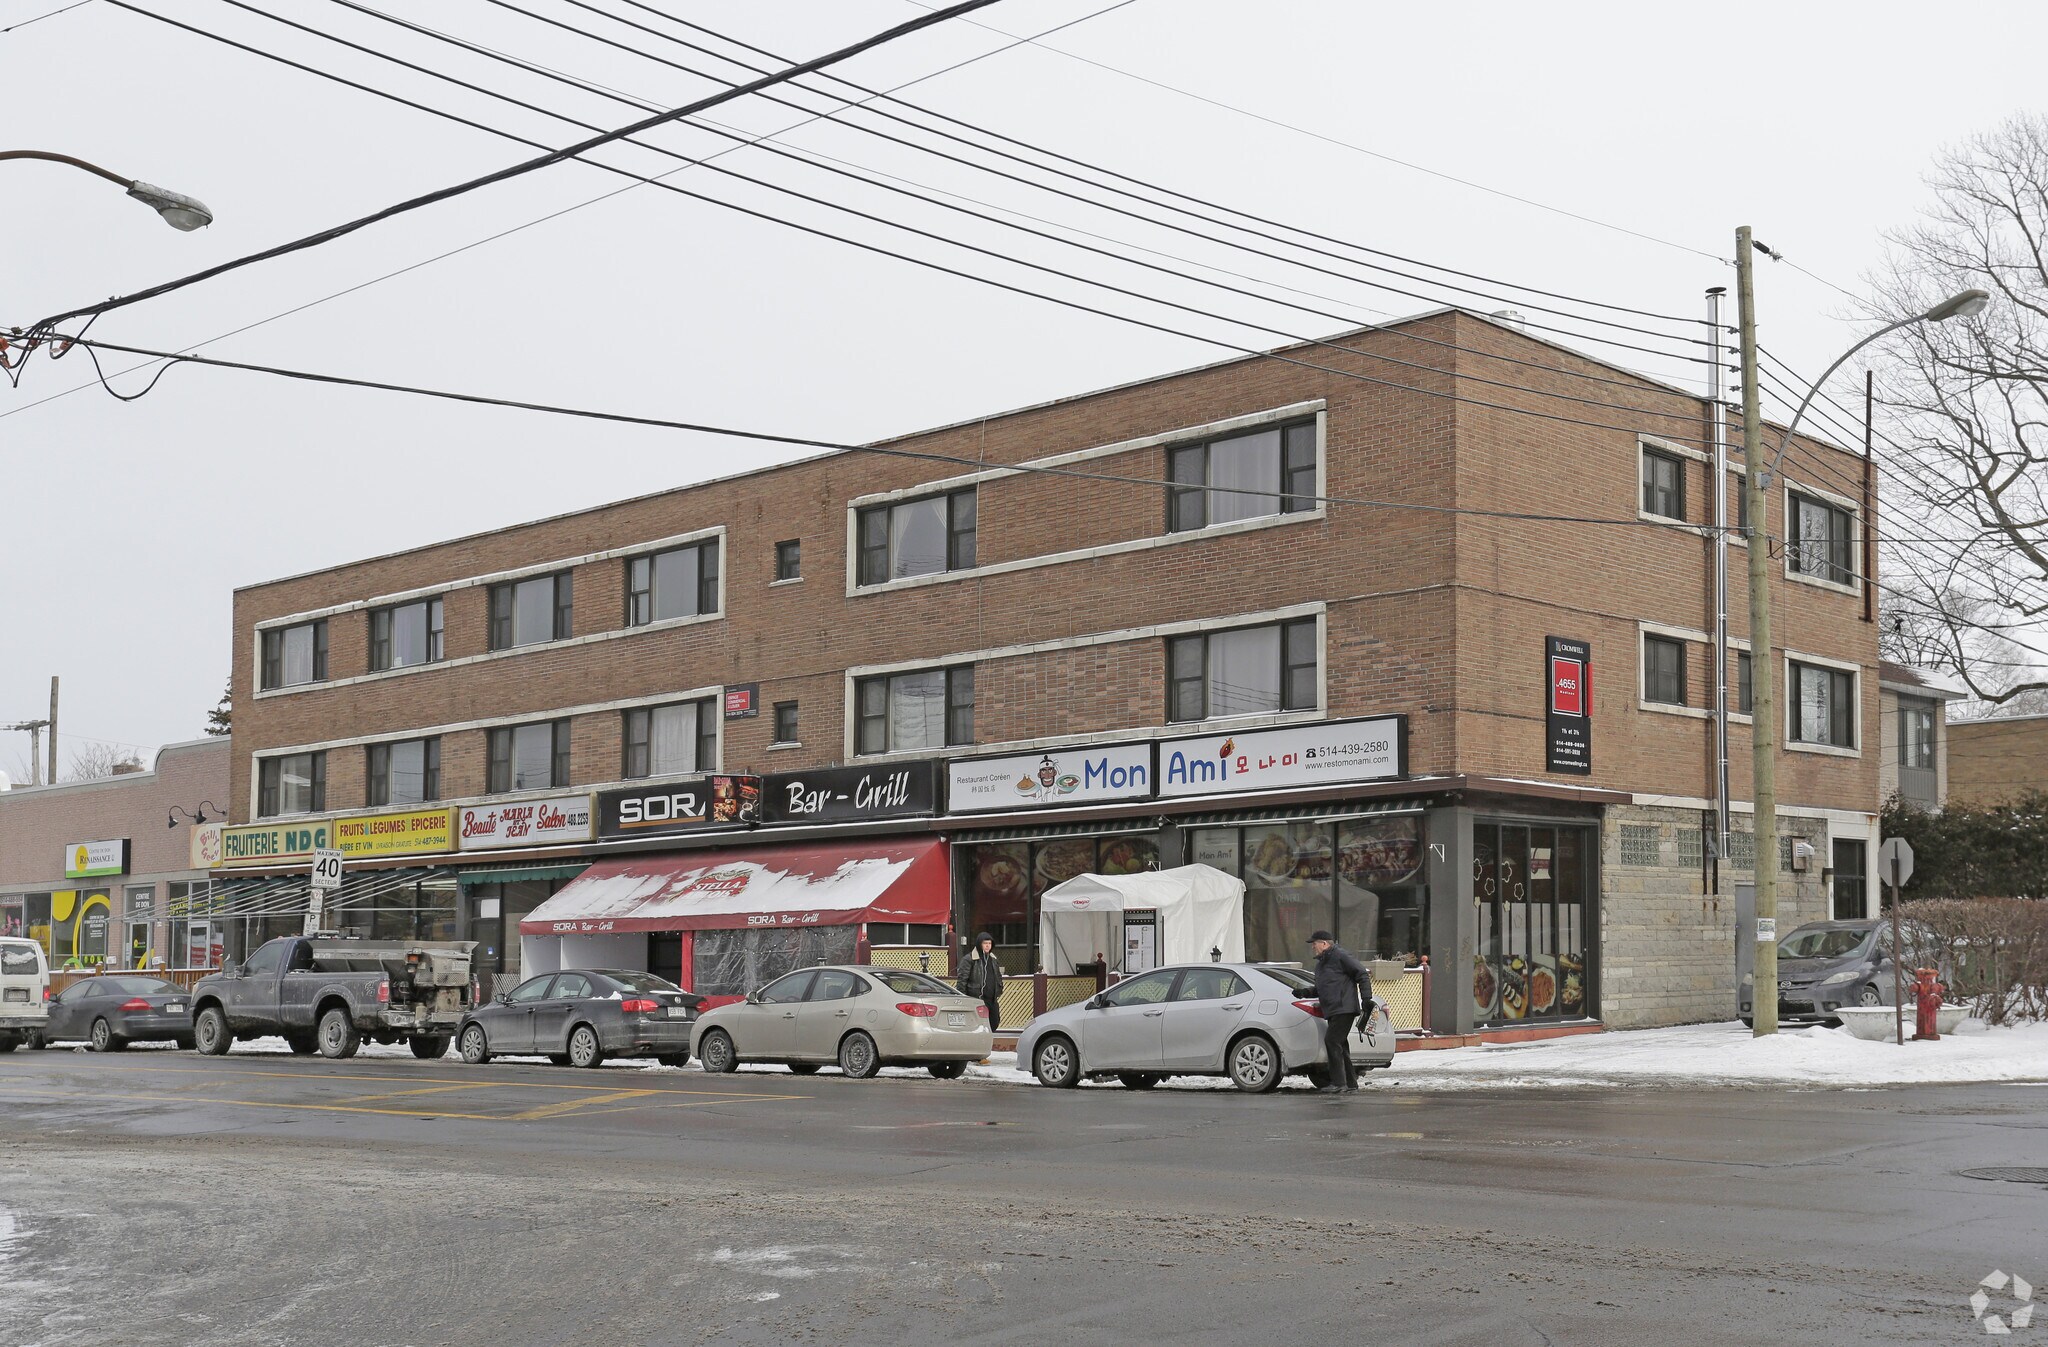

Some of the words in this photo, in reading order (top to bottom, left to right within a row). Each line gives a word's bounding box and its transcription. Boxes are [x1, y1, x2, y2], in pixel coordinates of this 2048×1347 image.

[1561, 644, 1584, 654] CROMWELL
[1559, 678, 1576, 690] 4655
[1319, 740, 1389, 757] 514-439-2580
[1084, 757, 1146, 790] Mon
[1168, 745, 1229, 785] Ami
[1304, 756, 1389, 770] www.restomonami.com
[956, 775, 989, 784] Restaurant
[786, 781, 832, 814] Bar
[855, 771, 910, 811] Grill
[340, 823, 365, 837] FRUITS
[370, 819, 406, 835] LÉGUMES
[411, 815, 446, 831] ÉPICERIE
[462, 810, 497, 838] Beauté
[536, 804, 567, 830] Salon
[505, 823, 531, 838] JEAN
[200, 829, 220, 846] Billy
[225, 831, 278, 857] FRUITERIE
[285, 828, 327, 852] NDG
[355, 842, 362, 850] ET
[363, 841, 373, 850] VIN
[79, 854, 111, 865] RENAISSANCE
[1198, 851, 1215, 860] Mon
[1217, 849, 1232, 859] Ami
[315, 857, 339, 878] 40
[693, 881, 742, 891] STELLA
[135, 892, 150, 900] CENTRE
[141, 901, 150, 909] DON
[309, 914, 316, 923] P
[747, 915, 776, 925] SORA
[552, 922, 577, 931] SORA
